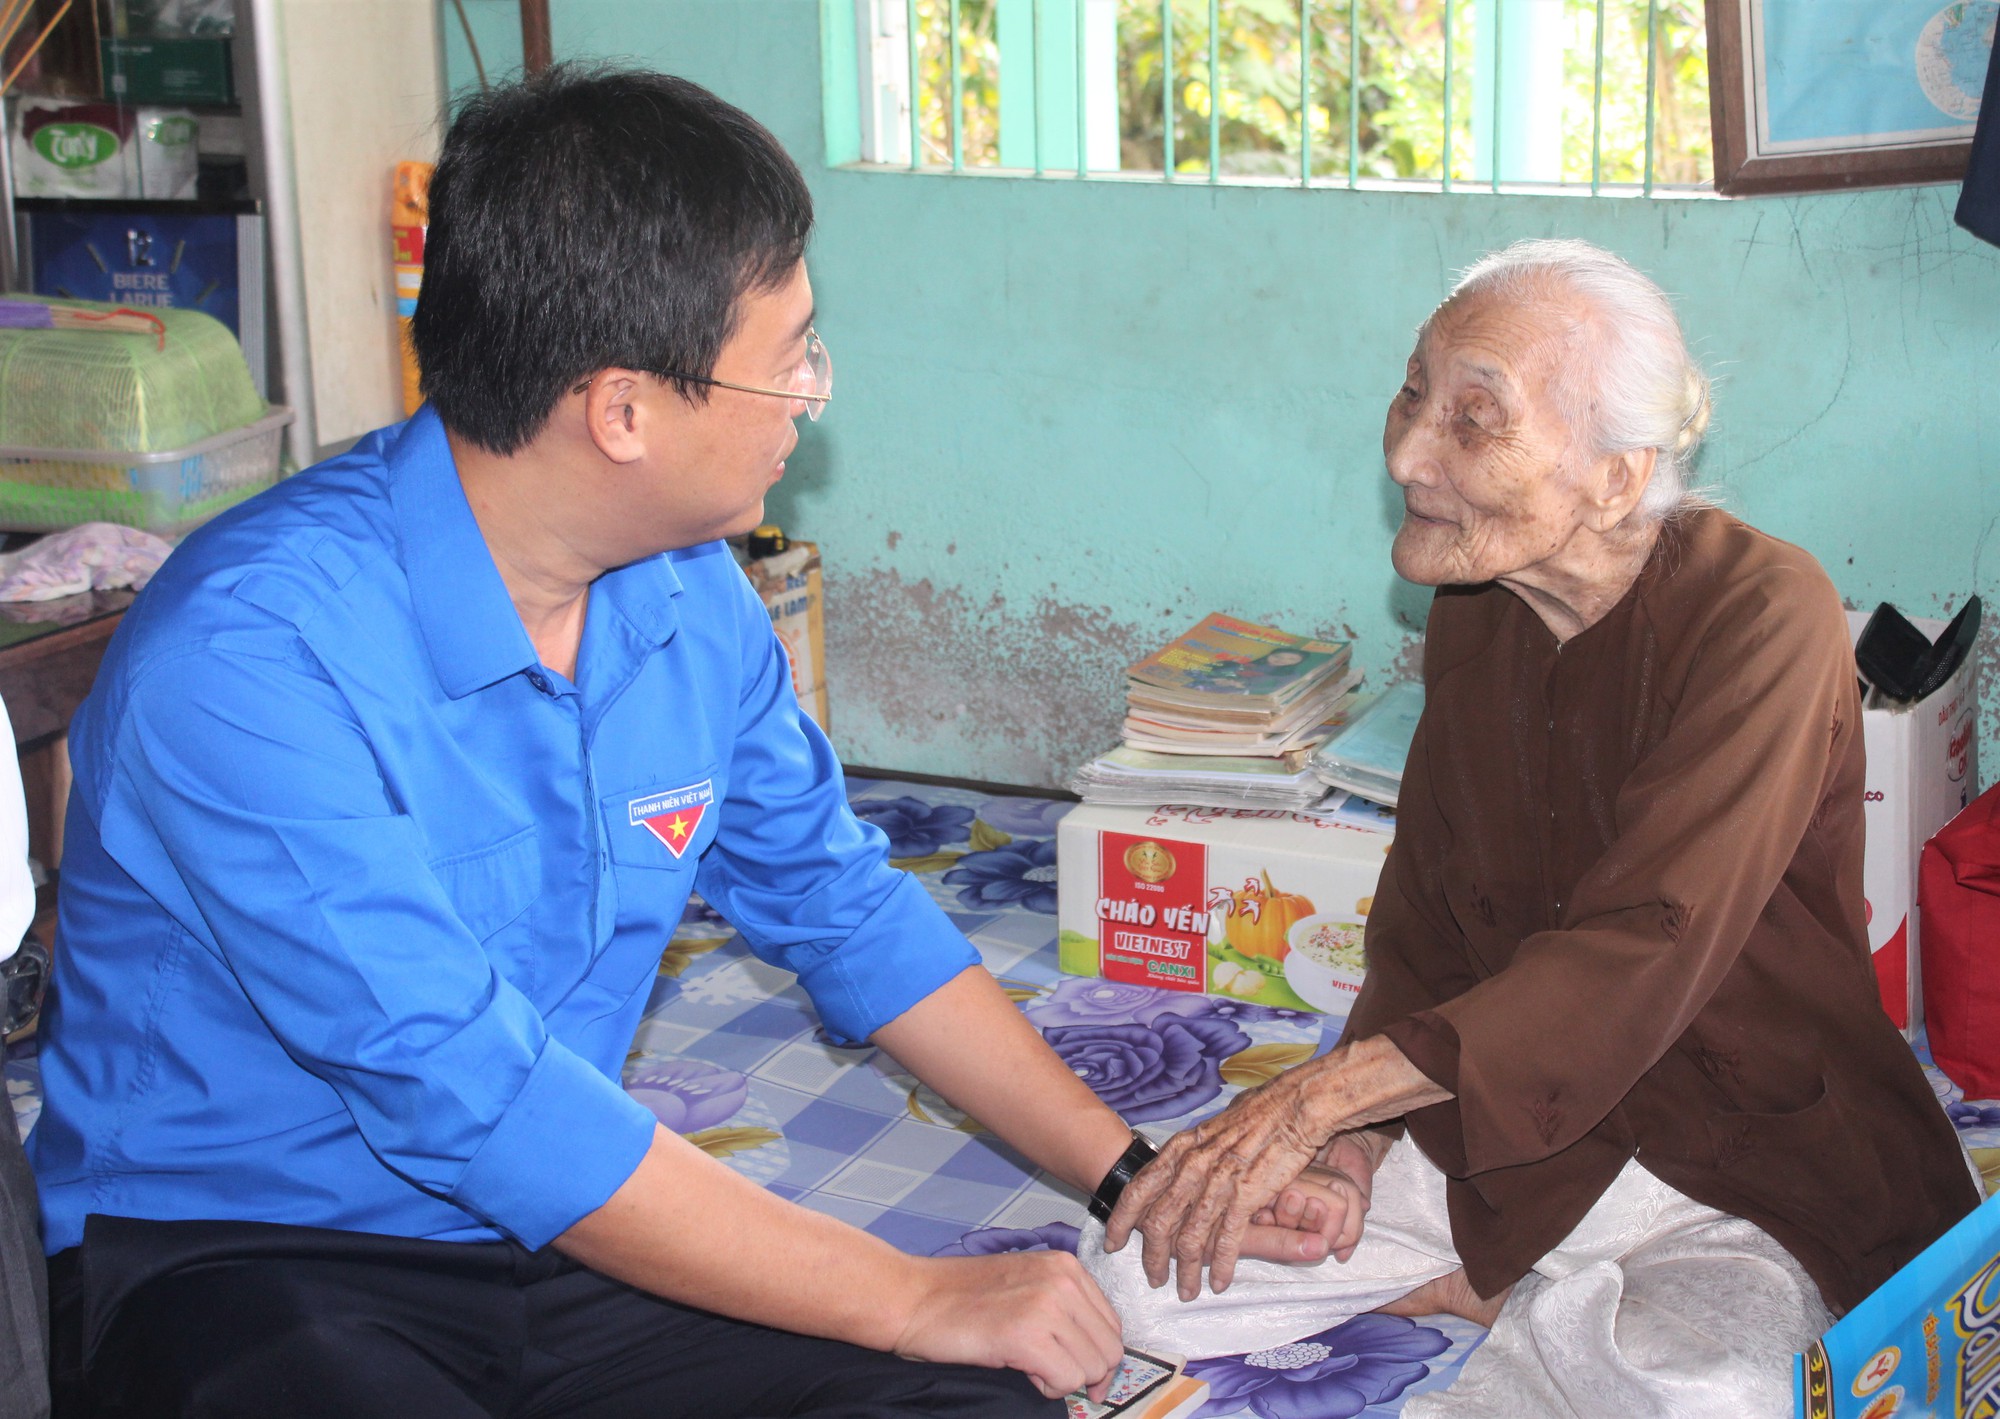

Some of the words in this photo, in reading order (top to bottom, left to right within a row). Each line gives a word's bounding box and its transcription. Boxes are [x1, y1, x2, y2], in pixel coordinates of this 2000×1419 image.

[113, 273, 169, 291] BIERE
[633, 801, 661, 817] THANH
[662, 796, 681, 810] NIÊN
[680, 791, 698, 805] VIỆT
[1096, 898, 1157, 928] CHÁO
[1163, 904, 1211, 936] YẾN
[1115, 931, 1191, 960] VIETNEST
[1147, 959, 1196, 978] CANXI
[1332, 980, 1361, 993] VIETN
